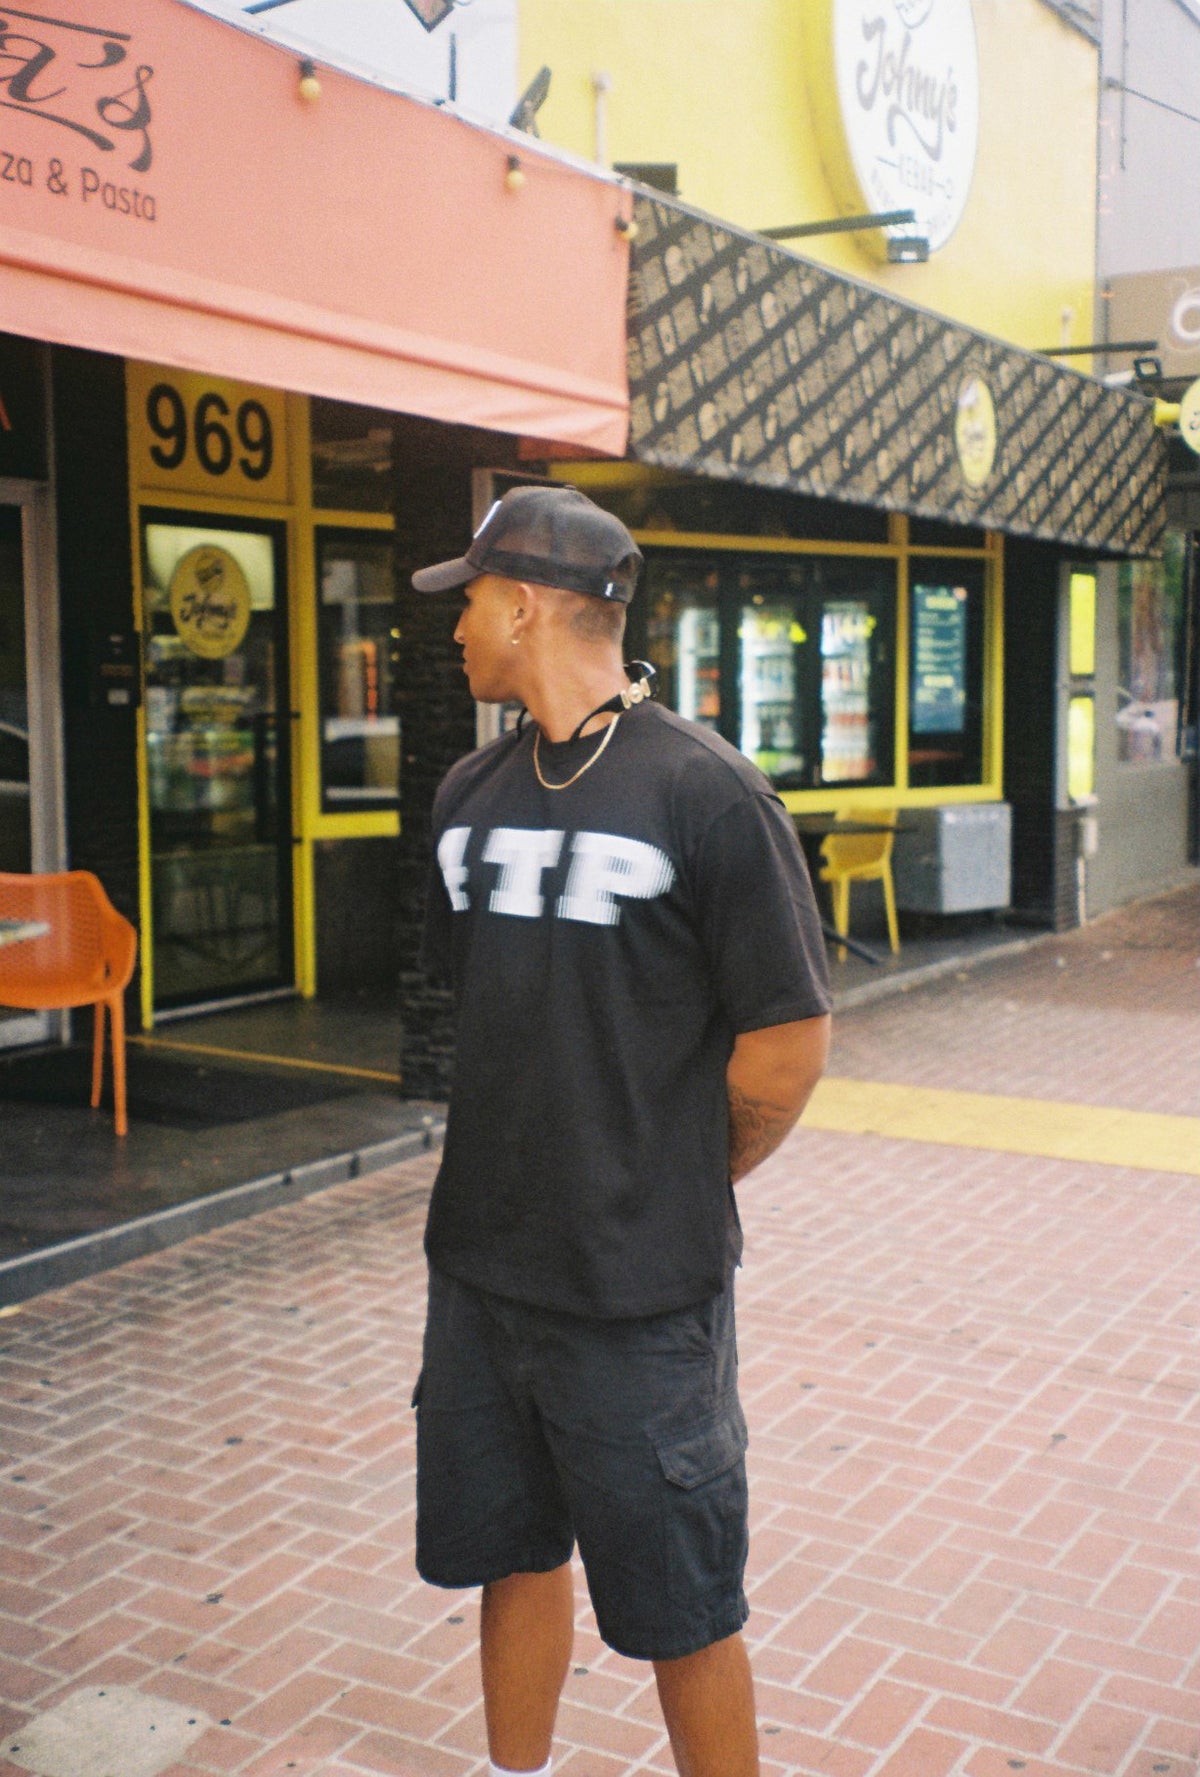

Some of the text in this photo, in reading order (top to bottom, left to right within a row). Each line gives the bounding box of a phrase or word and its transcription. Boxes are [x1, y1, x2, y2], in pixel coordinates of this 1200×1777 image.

[855, 15, 958, 162] Johny's
[46, 158, 68, 195] &
[80, 166, 156, 221] Pasta
[146, 383, 274, 481] 969
